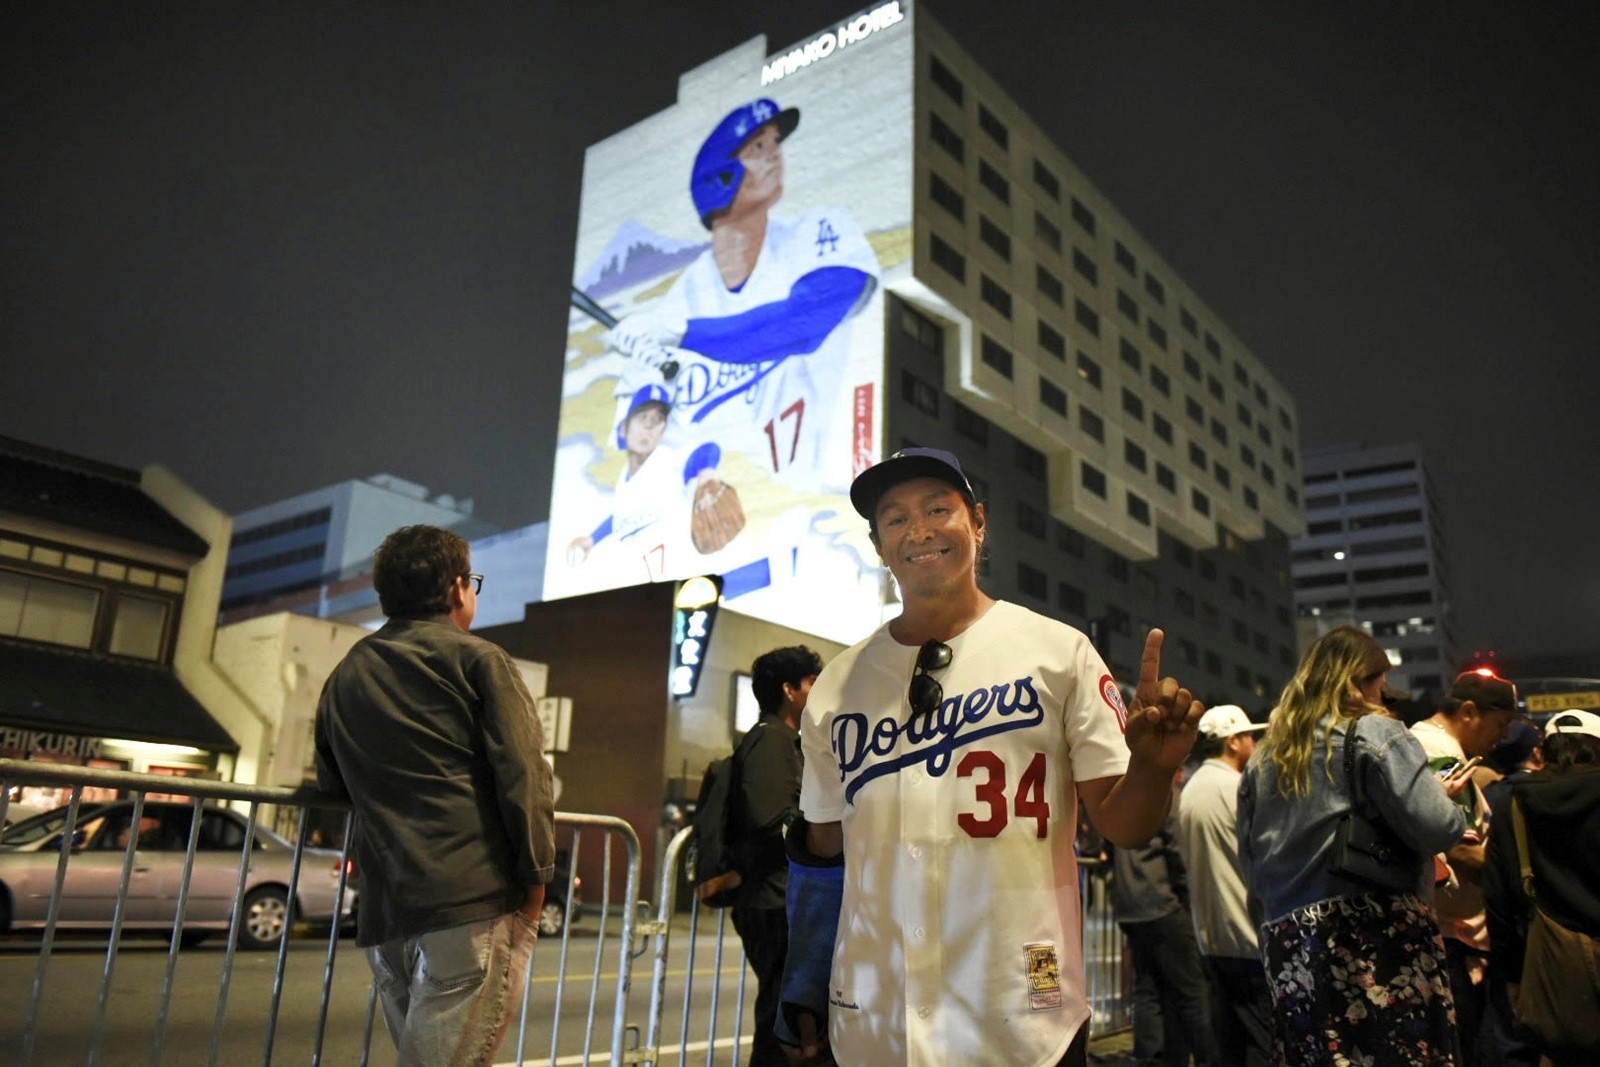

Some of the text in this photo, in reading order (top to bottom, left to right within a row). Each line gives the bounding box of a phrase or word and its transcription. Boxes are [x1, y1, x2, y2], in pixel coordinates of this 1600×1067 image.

[760, 0, 904, 86] MIYAKO HOTEL
[815, 218, 840, 257] LA
[764, 397, 805, 473] 17
[642, 543, 665, 581] 17
[831, 676, 1044, 782] Dodgers
[956, 750, 1050, 839] 34
